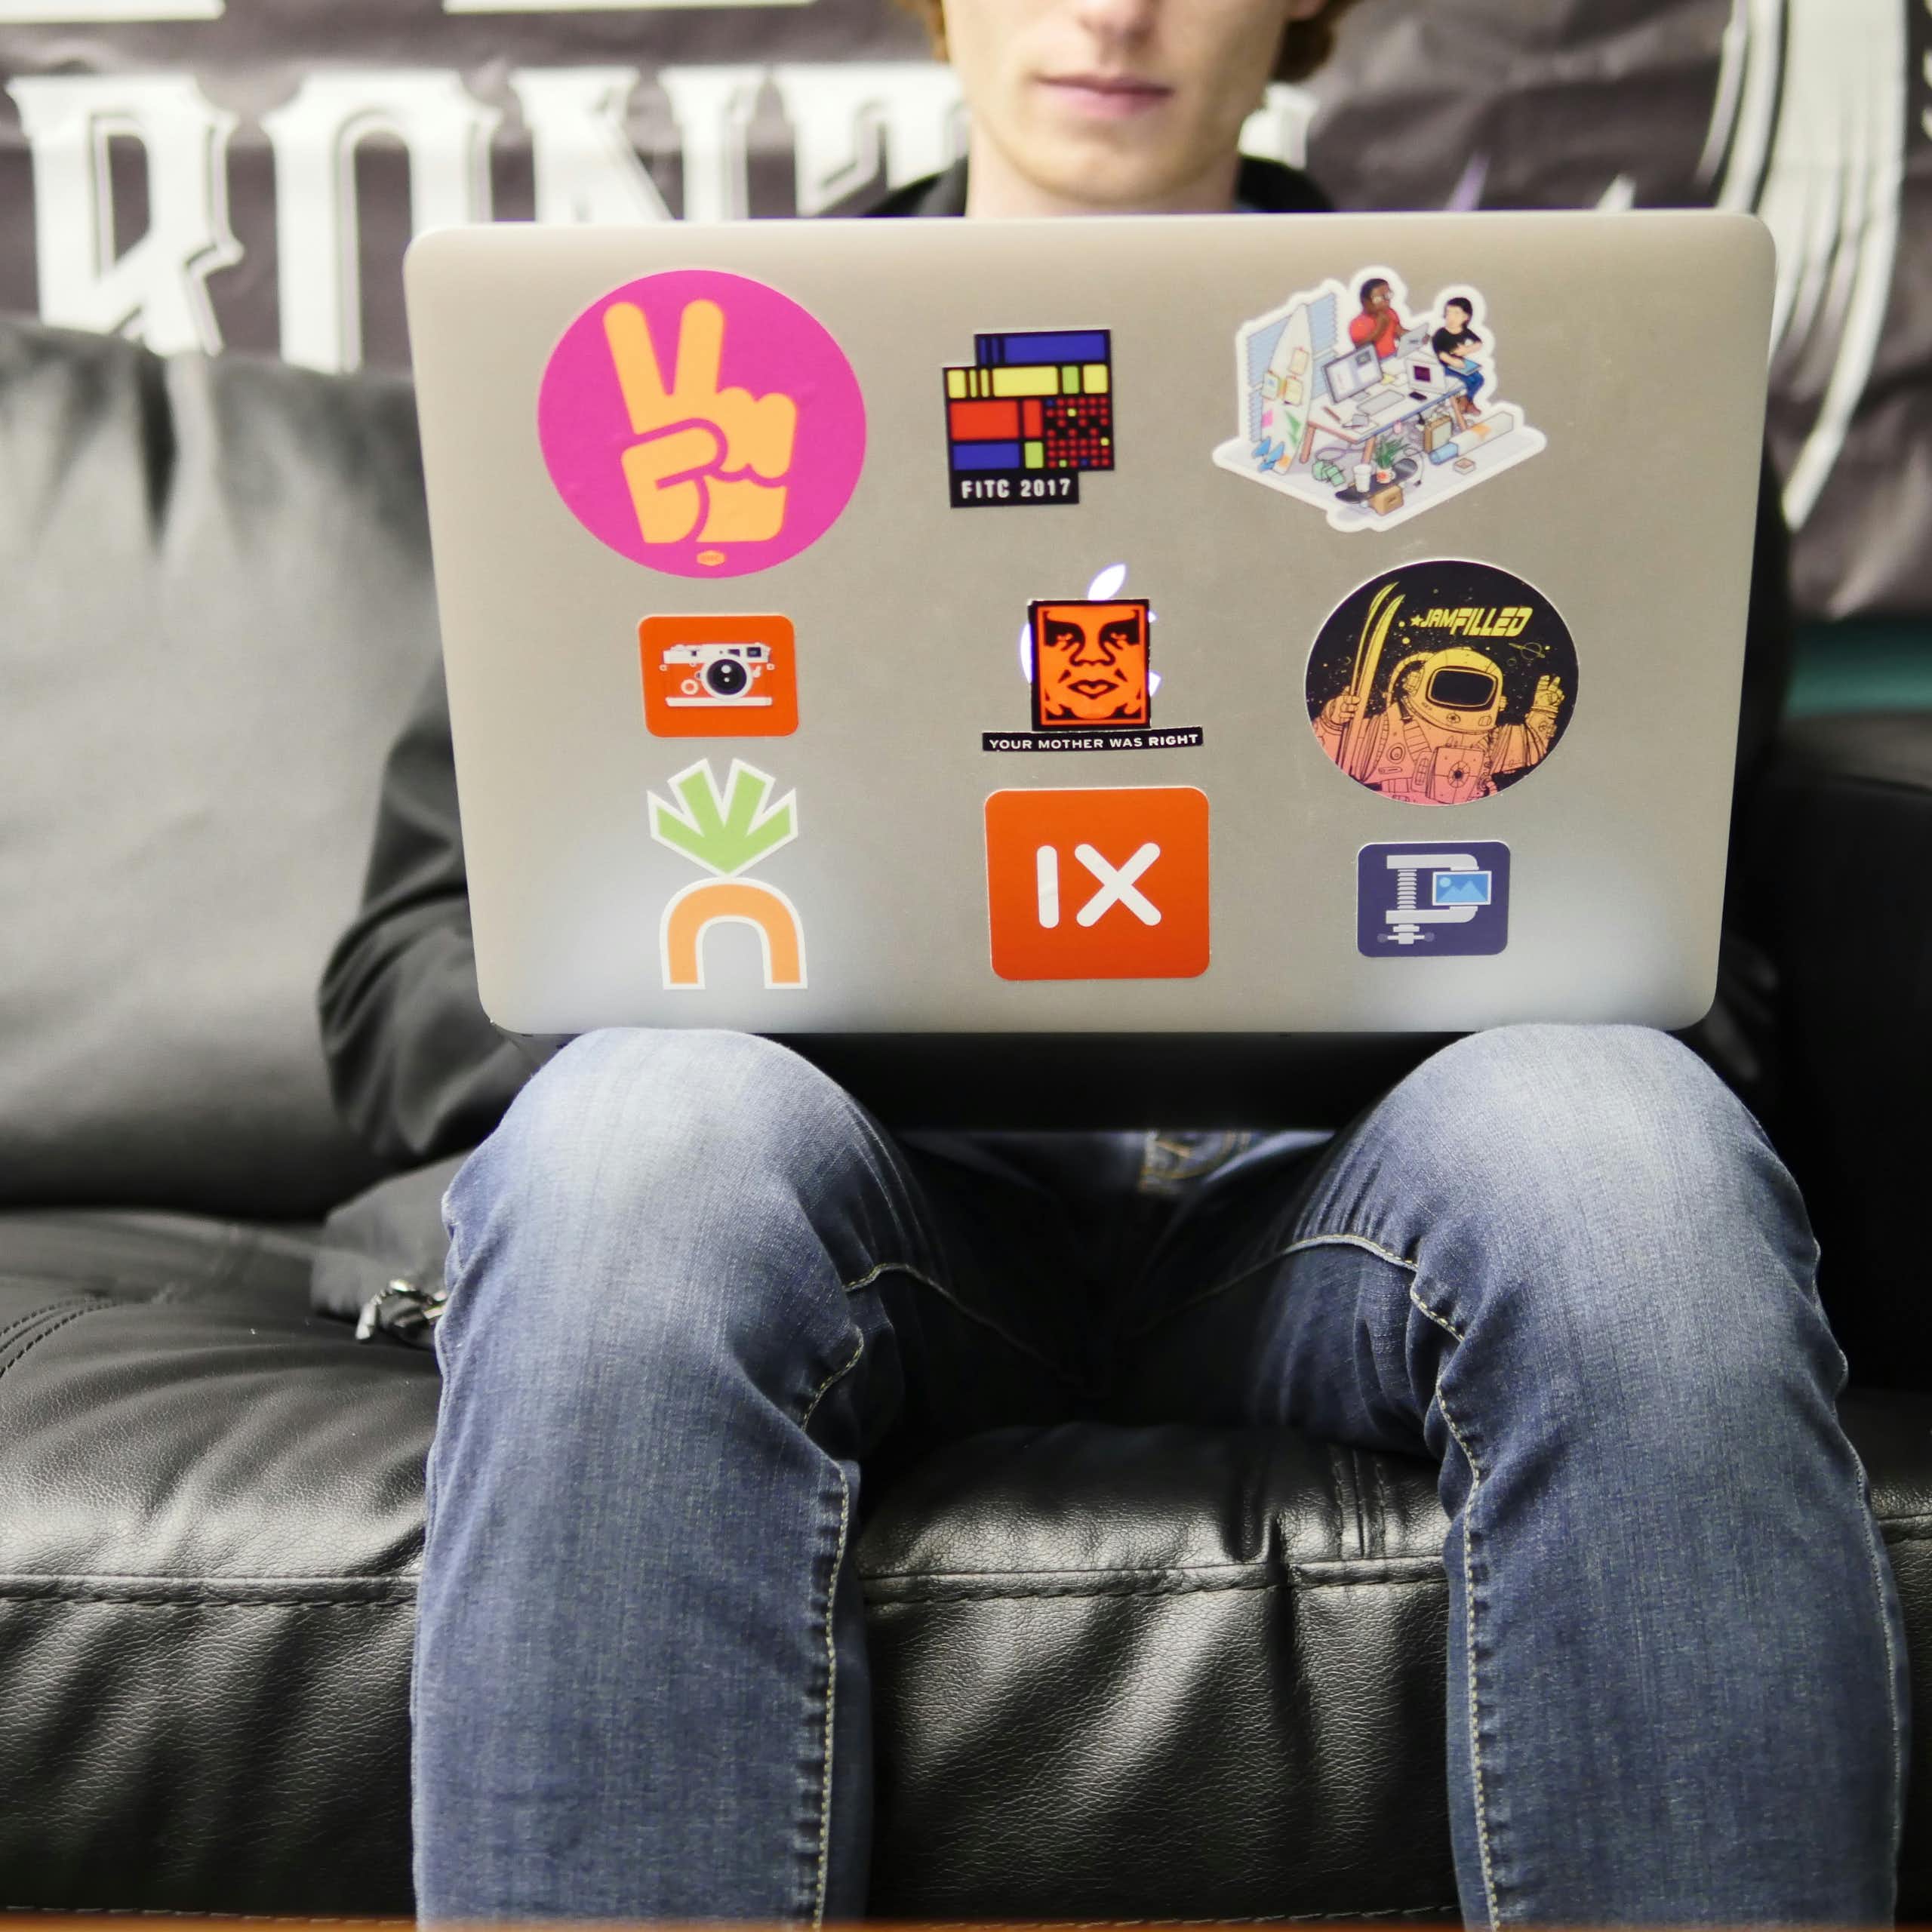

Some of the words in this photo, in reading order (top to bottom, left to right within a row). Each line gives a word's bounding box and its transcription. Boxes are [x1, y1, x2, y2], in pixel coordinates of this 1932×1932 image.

[961, 478, 1011, 499] FITC
[1020, 478, 1071, 497] 2017
[989, 739, 1032, 749] YOUR
[1038, 738, 1103, 749] MOTHER
[1109, 737, 1143, 748] WAS
[1148, 734, 1198, 746] RIGHT
[1035, 842, 1162, 929] IX
